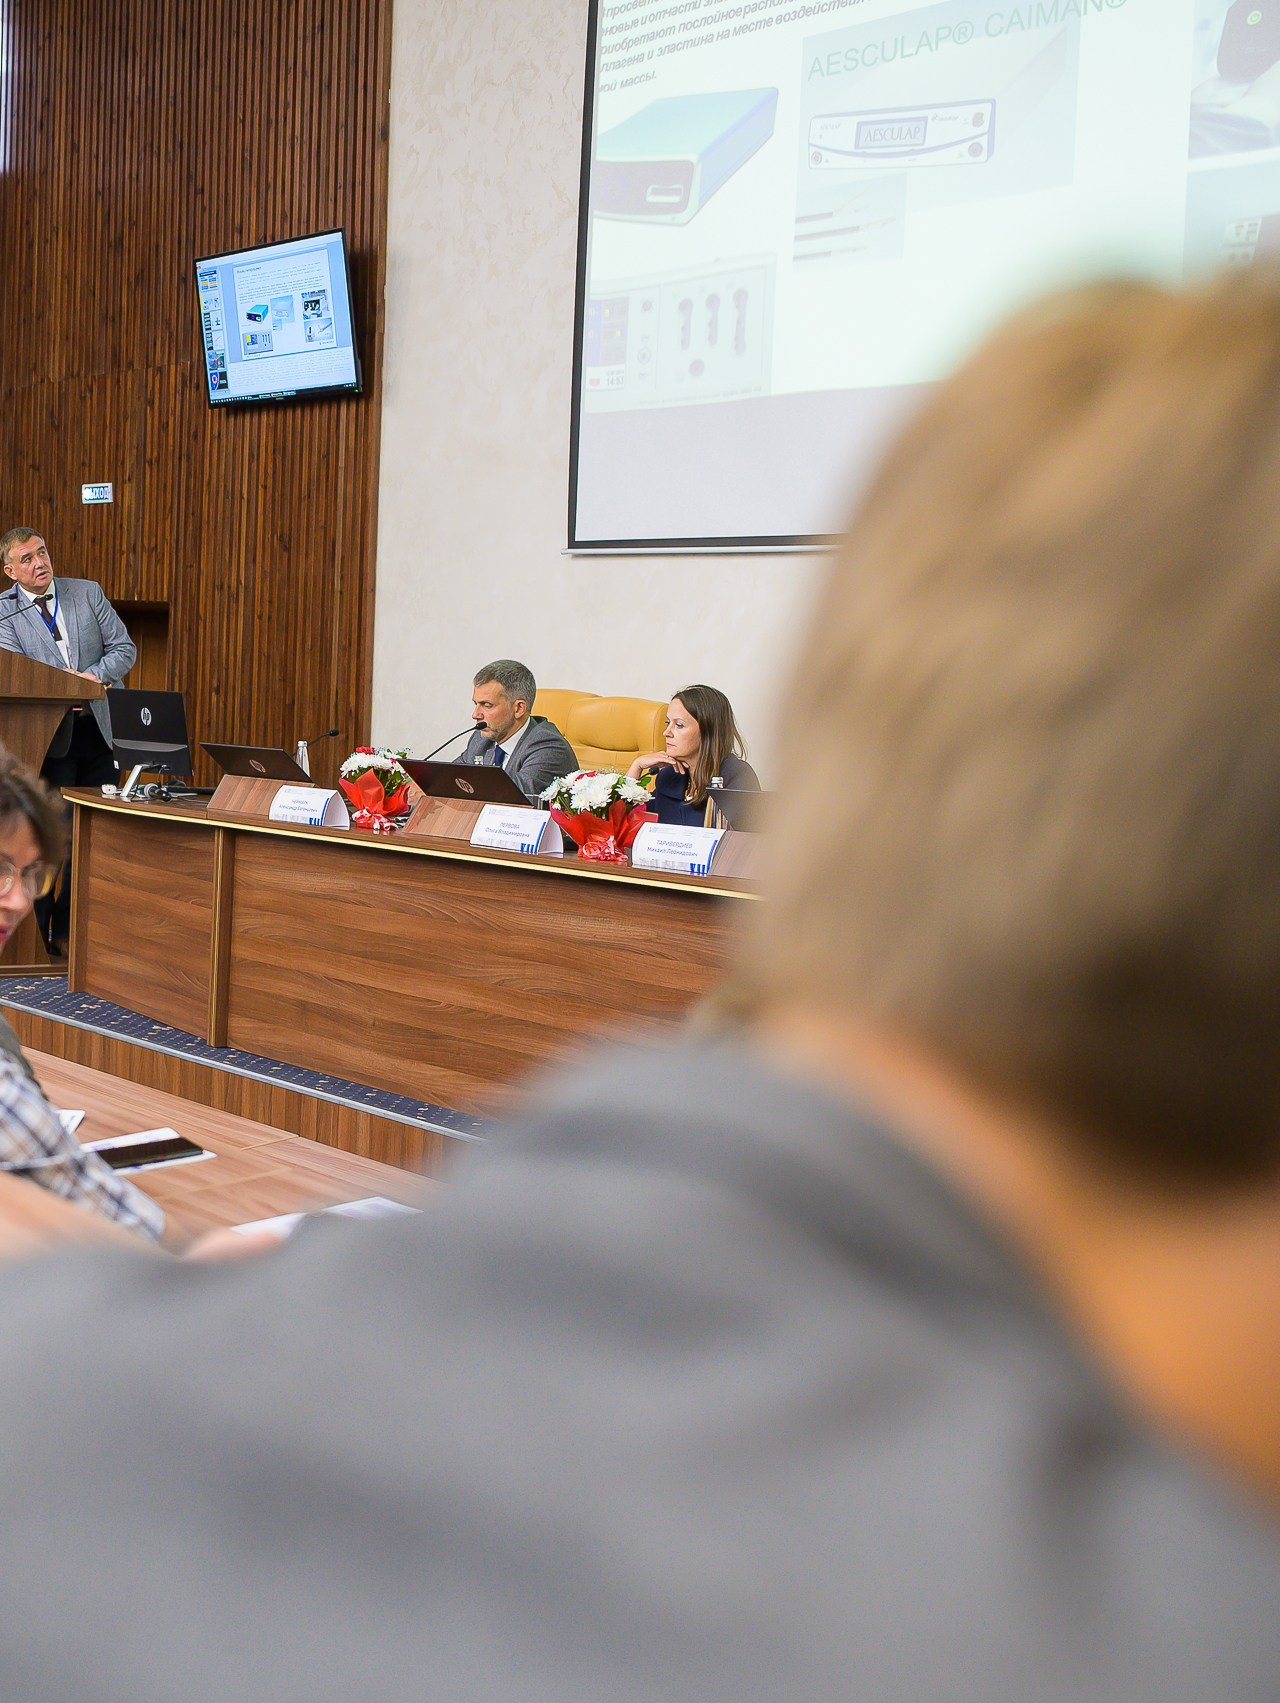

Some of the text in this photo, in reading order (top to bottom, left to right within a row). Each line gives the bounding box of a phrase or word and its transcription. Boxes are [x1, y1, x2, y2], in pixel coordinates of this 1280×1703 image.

[602, 18, 639, 36] новые
[656, 33, 715, 57] эластина
[715, 28, 731, 42] на
[732, 16, 775, 37] месте
[620, 71, 658, 89] массы.
[864, 126, 921, 143] AESCULAP
[647, 846, 666, 854] Михаил
